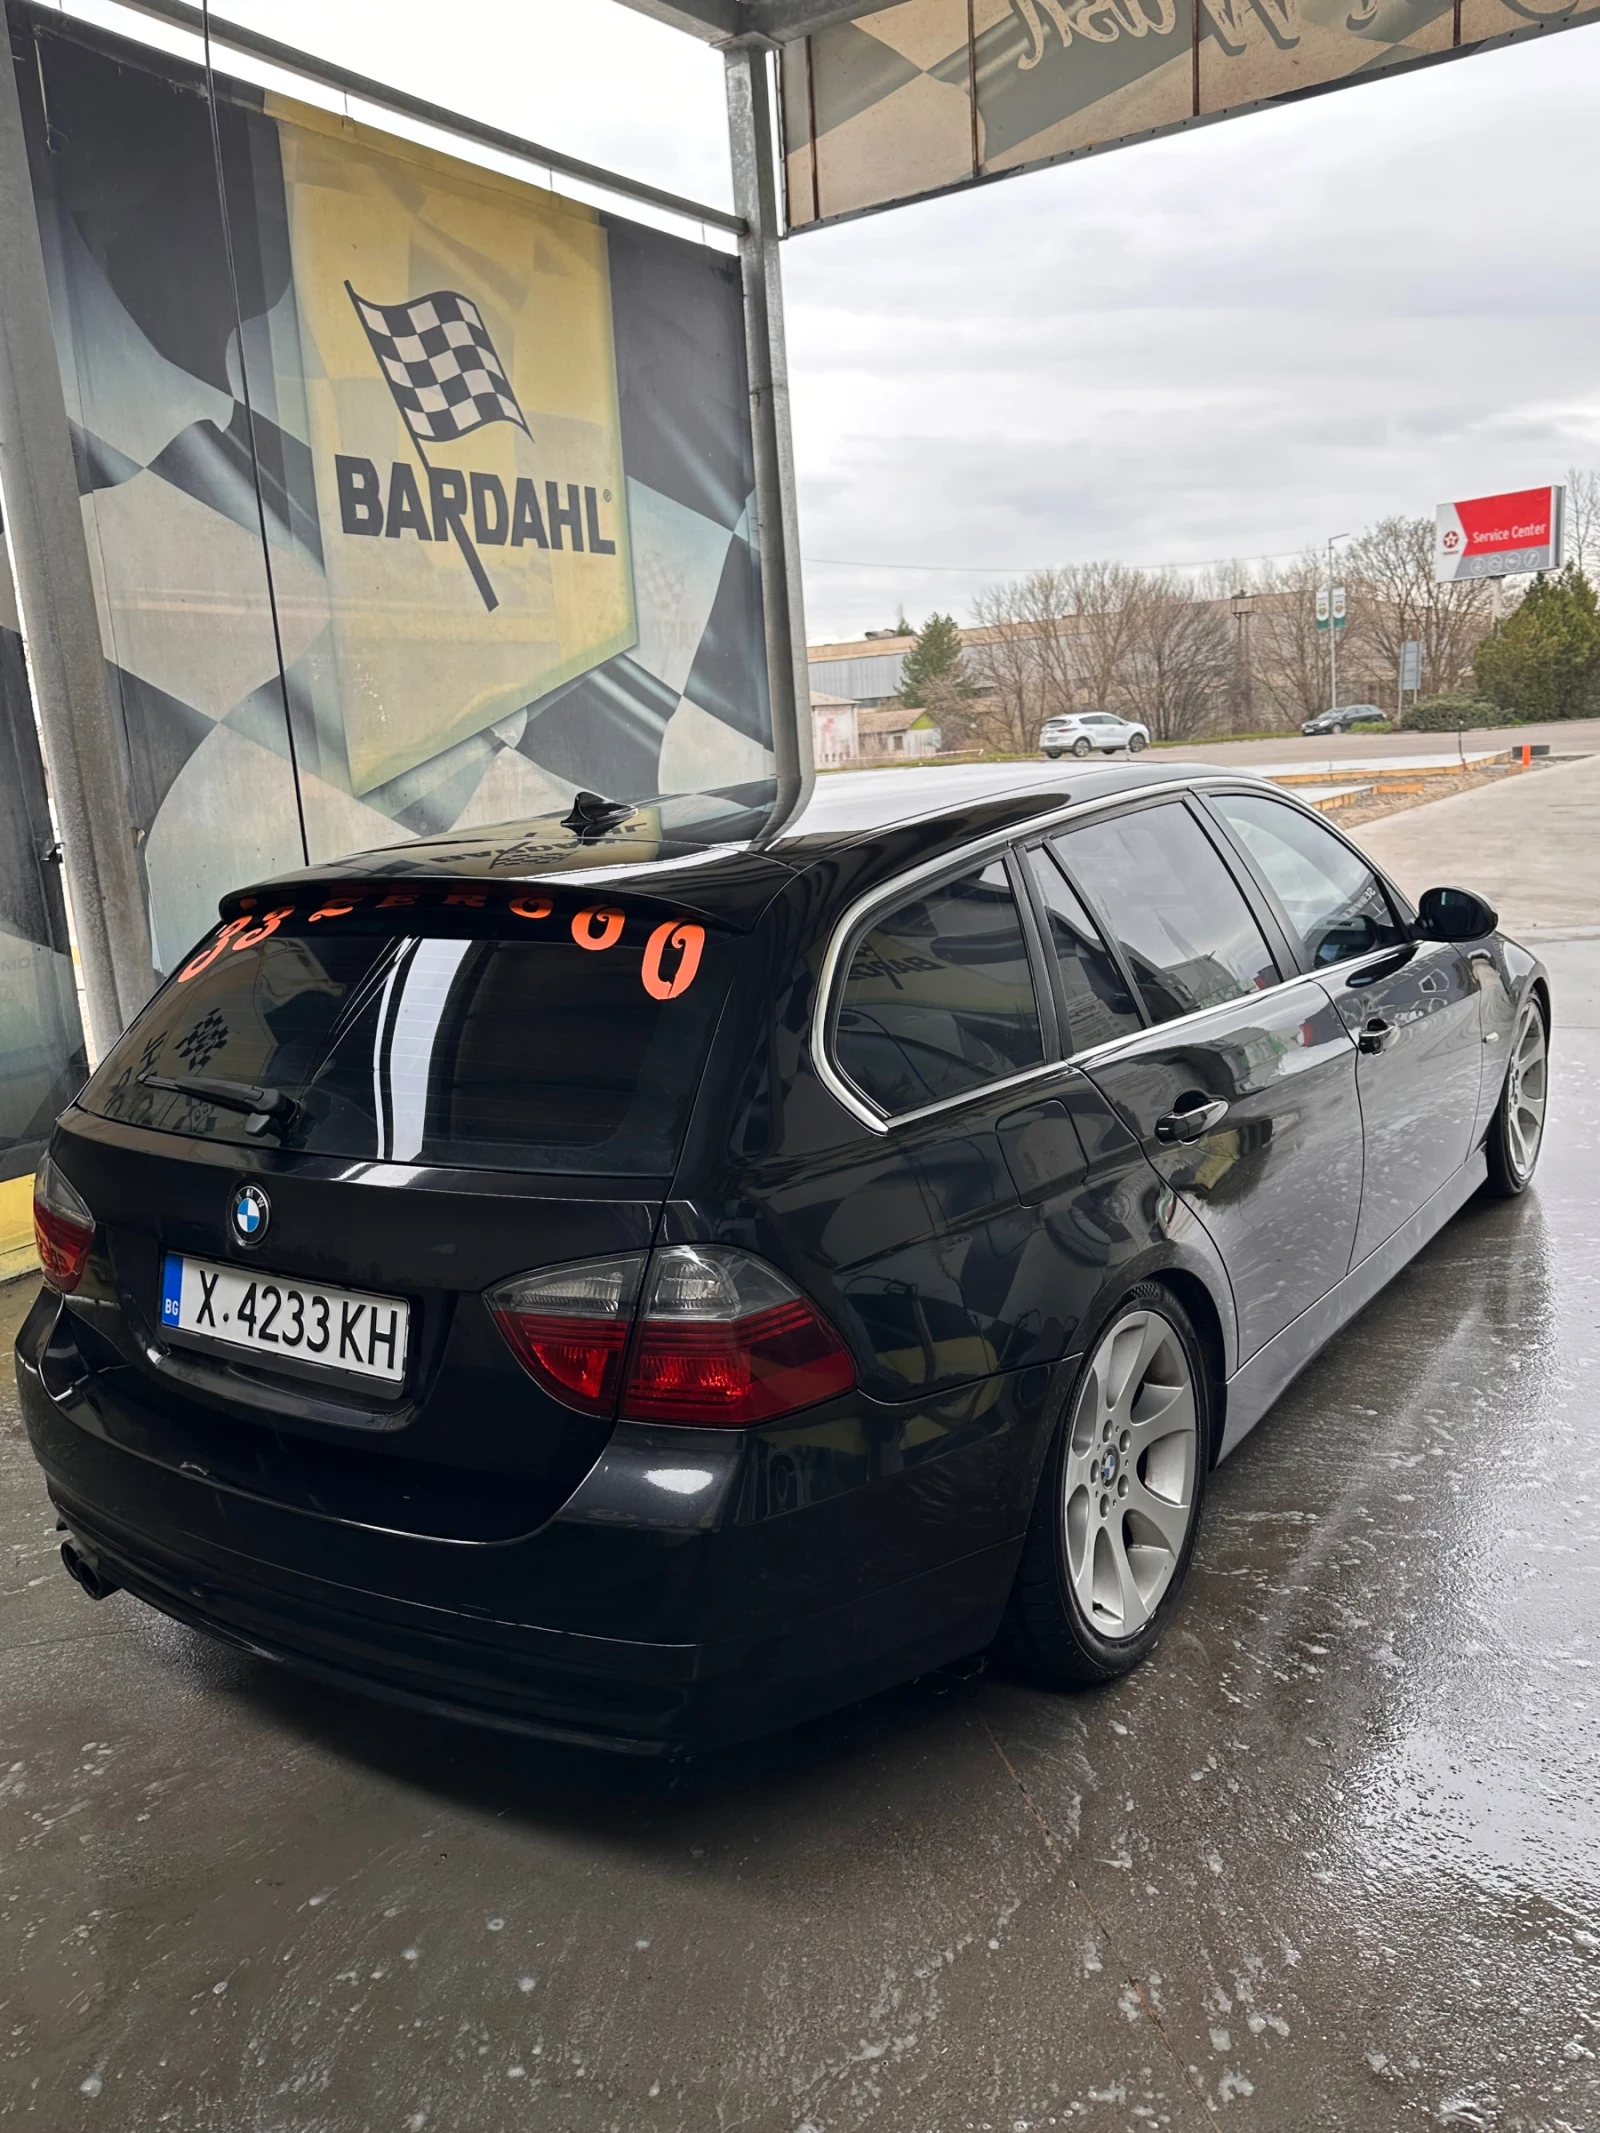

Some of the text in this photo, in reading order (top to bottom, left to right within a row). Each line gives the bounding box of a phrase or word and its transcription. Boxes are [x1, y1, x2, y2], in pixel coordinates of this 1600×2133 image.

[334, 454, 617, 556] BARDAHL
[1472, 523, 1547, 544] Service Center
[164, 1298, 179, 1316] BG
